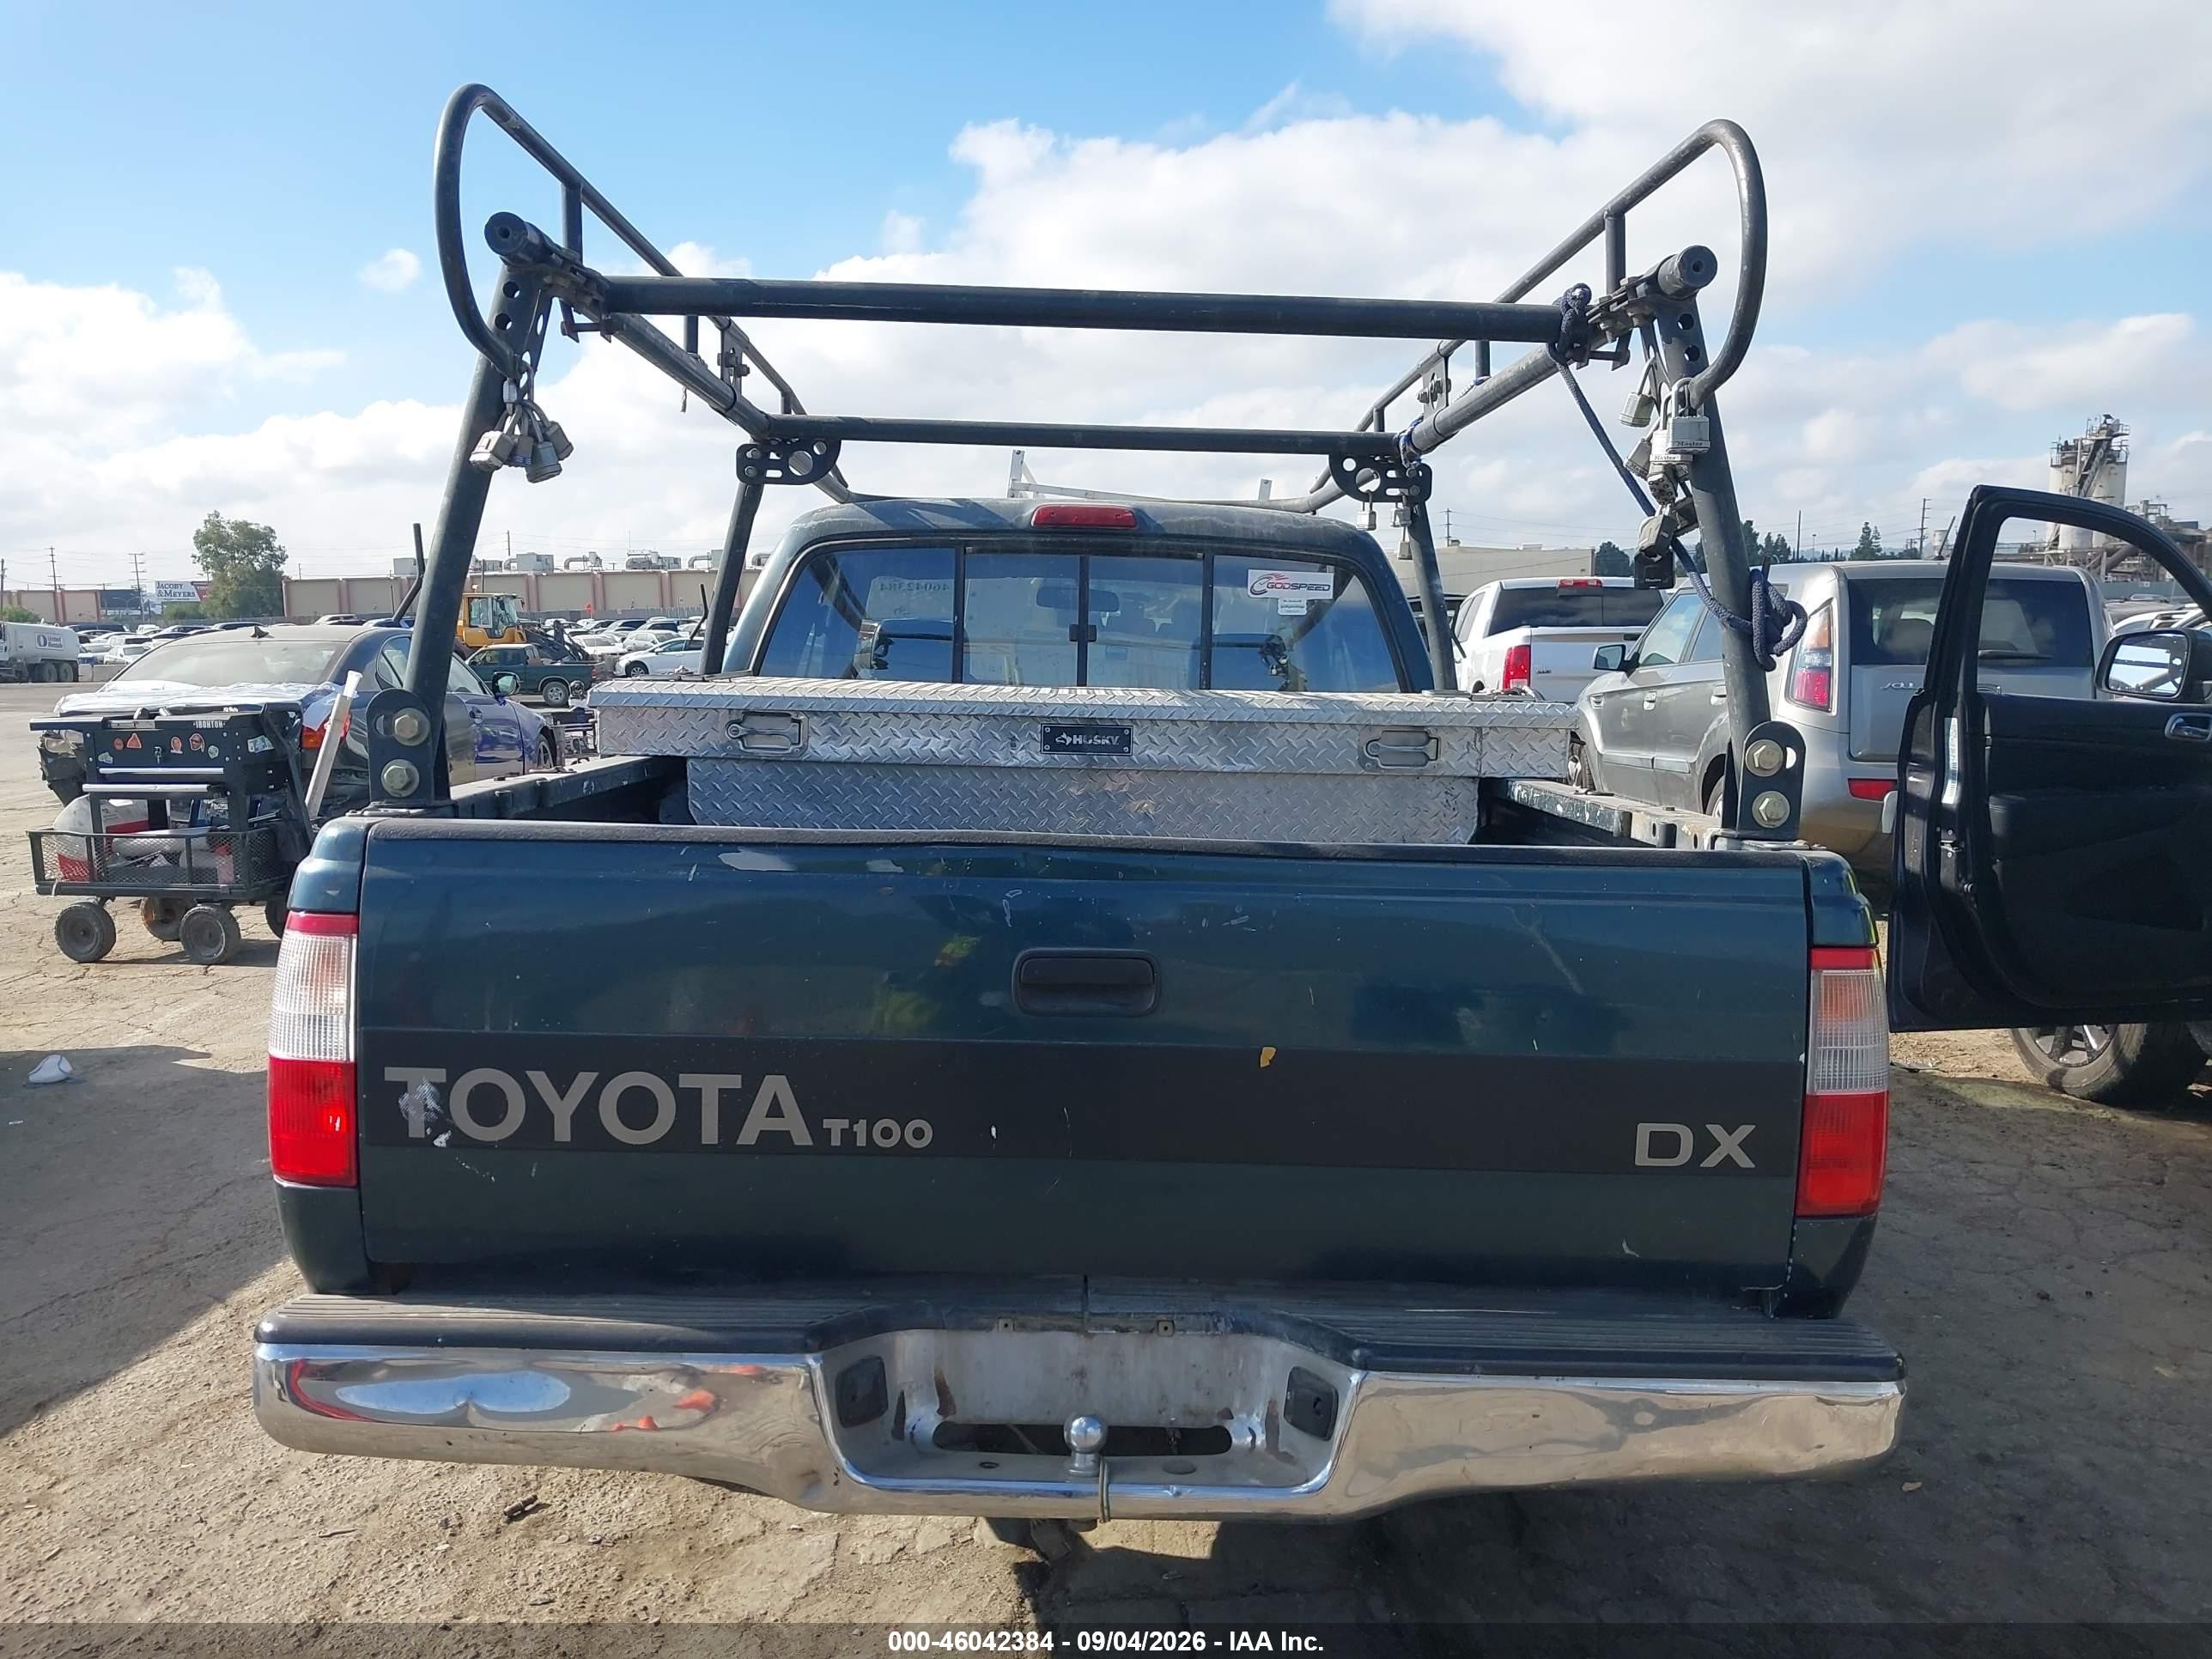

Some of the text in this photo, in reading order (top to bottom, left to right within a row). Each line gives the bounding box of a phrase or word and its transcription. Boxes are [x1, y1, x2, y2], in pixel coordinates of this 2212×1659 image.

[156, 581, 184, 590] JACOBY
[1266, 582, 1331, 592] GODSPEED
[1073, 734, 1120, 745] HUSKY
[384, 1066, 933, 1149] TOYOTA T100
[1634, 1122, 1757, 1169] DX
